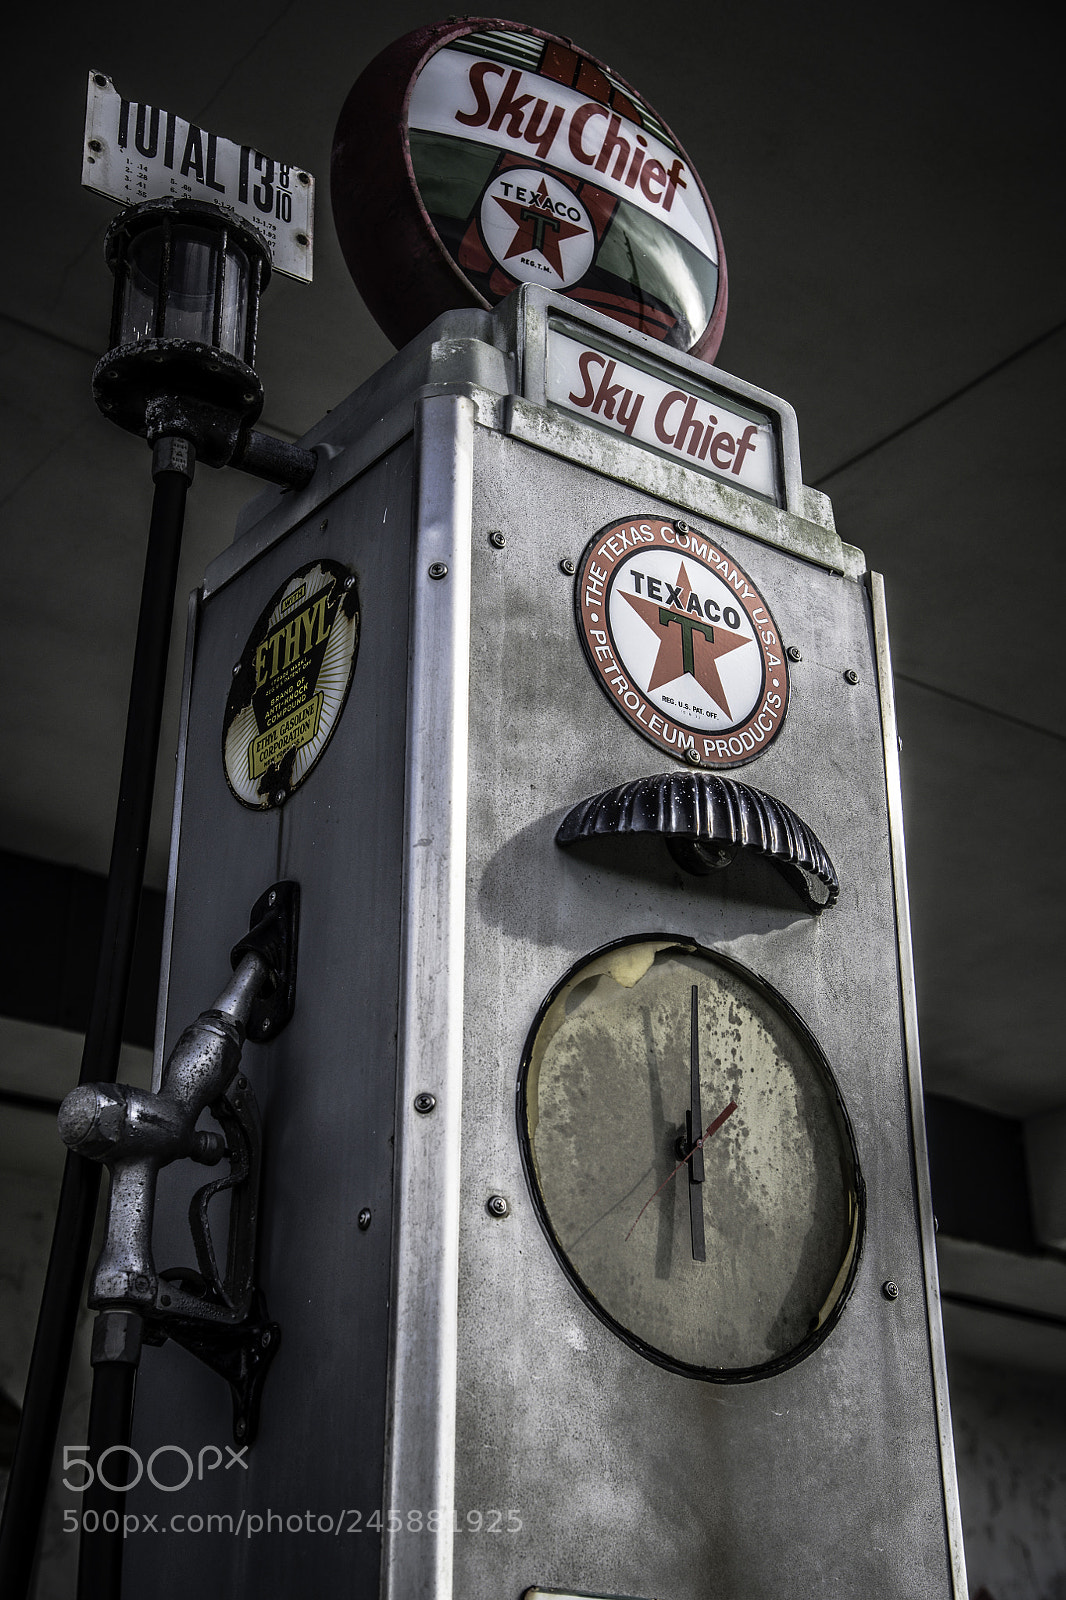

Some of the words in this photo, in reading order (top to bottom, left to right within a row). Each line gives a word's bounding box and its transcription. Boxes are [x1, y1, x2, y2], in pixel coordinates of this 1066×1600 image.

[454, 61, 565, 159] Sky
[568, 102, 688, 213] Chief
[500, 181, 581, 222] TEXACO
[520, 208, 560, 252] T
[568, 351, 645, 437] Sky
[654, 390, 758, 476] Chief
[586, 562, 608, 608] THE
[597, 524, 655, 563] TEXAS
[659, 526, 756, 600] COMPANY
[751, 606, 781, 672] U.S.A.
[630, 570, 741, 630] TEXACO
[256, 595, 331, 689] ETHYL
[658, 608, 715, 676] T
[266, 694, 307, 727] COMPOUND
[270, 685, 294, 706] BRAND
[296, 676, 306, 687] OF
[590, 628, 695, 749] PETROLEUM
[703, 690, 782, 758] PRODUCTS
[662, 695, 677, 706] REG.
[678, 701, 691, 711] U.S.
[692, 705, 704, 716] PAT.
[705, 710, 720, 721] OFF.
[259, 719, 311, 762] CORPORATION
[280, 702, 315, 736] GASOLINE
